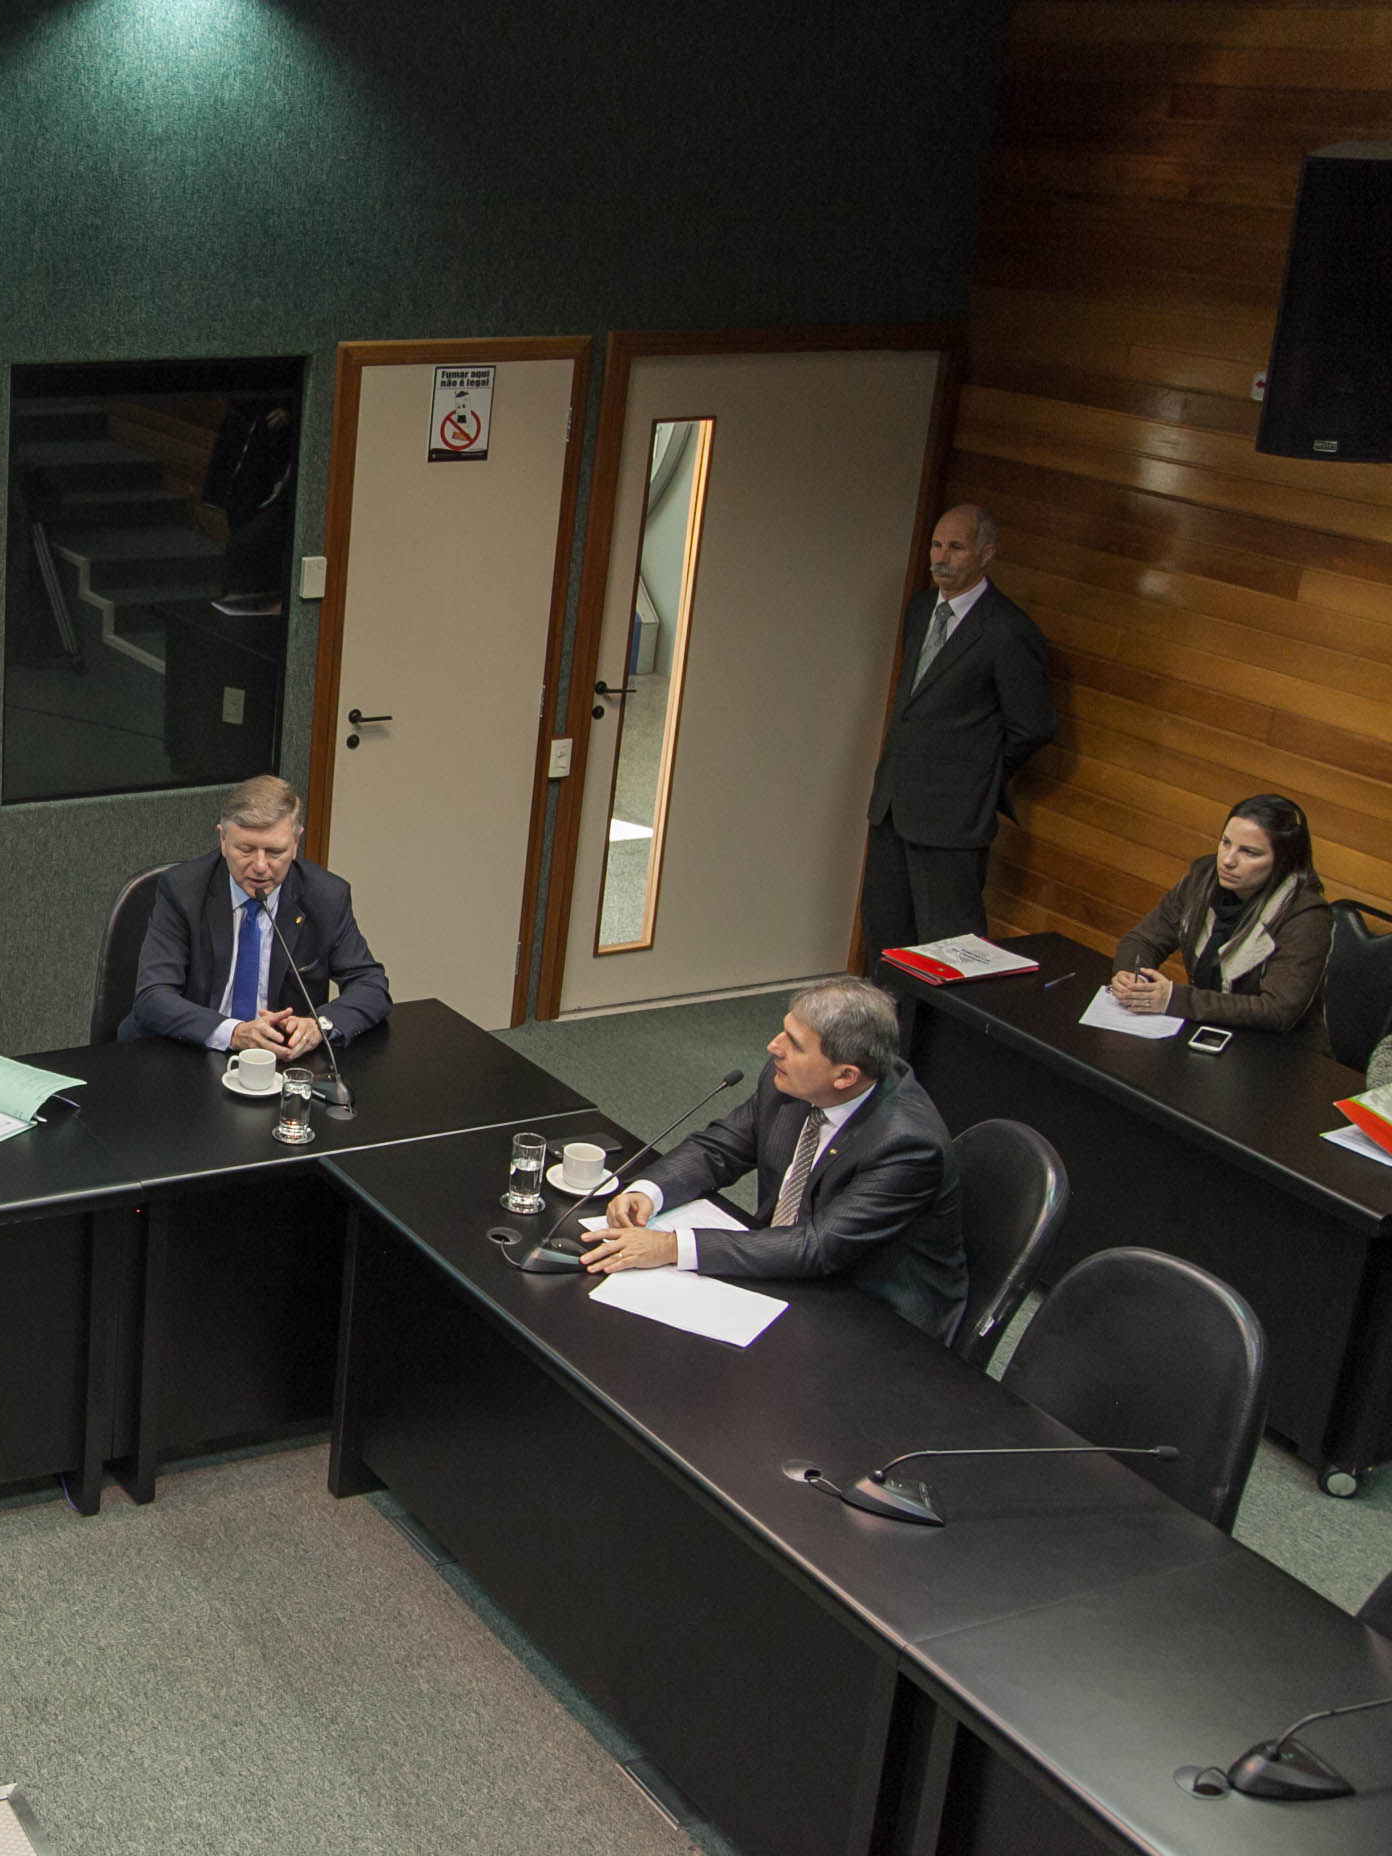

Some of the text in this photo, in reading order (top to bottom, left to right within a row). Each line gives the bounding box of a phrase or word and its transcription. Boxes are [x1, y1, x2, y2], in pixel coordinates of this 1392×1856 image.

[441, 370, 490, 379] Fumar aqui
[440, 379, 457, 387] não
